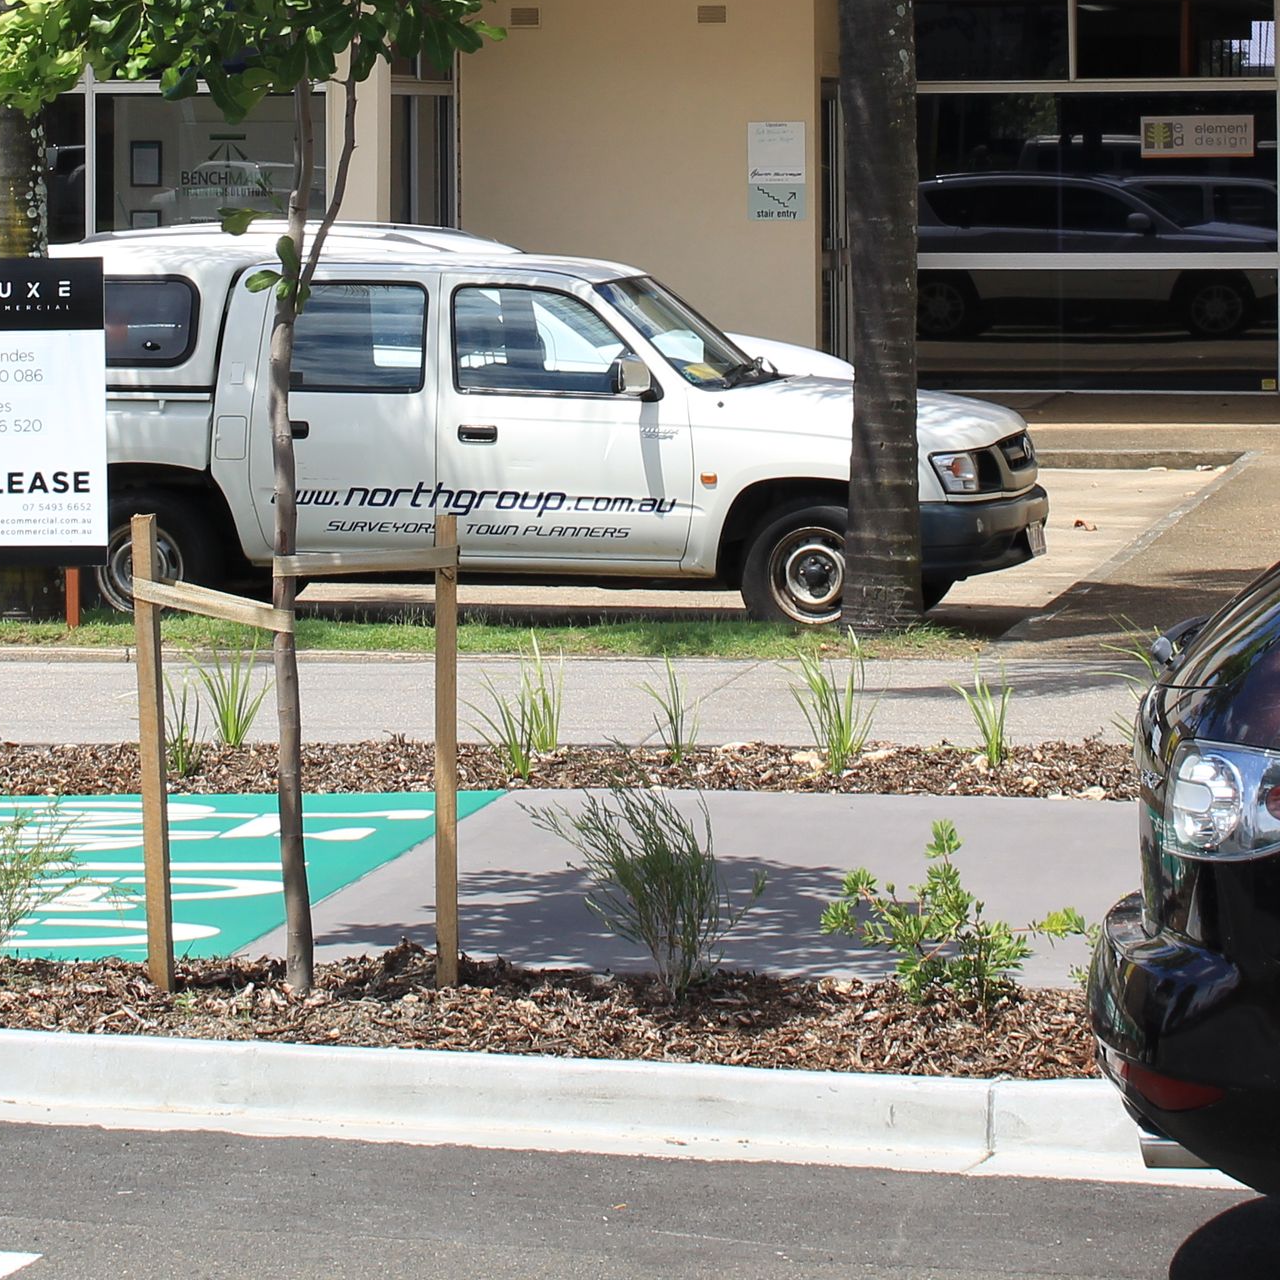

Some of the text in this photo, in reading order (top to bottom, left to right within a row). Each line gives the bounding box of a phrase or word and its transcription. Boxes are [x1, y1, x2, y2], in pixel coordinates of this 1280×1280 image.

[1195, 123, 1248, 134] element
[1194, 135, 1248, 147] design
[756, 209, 798, 220] stair entry
[13, 368, 44, 383] 086
[13, 418, 43, 433] 520
[22, 502, 92, 512] 07 5493 6652
[326, 520, 631, 539] SURVEYORS TOWN PLANNERS
